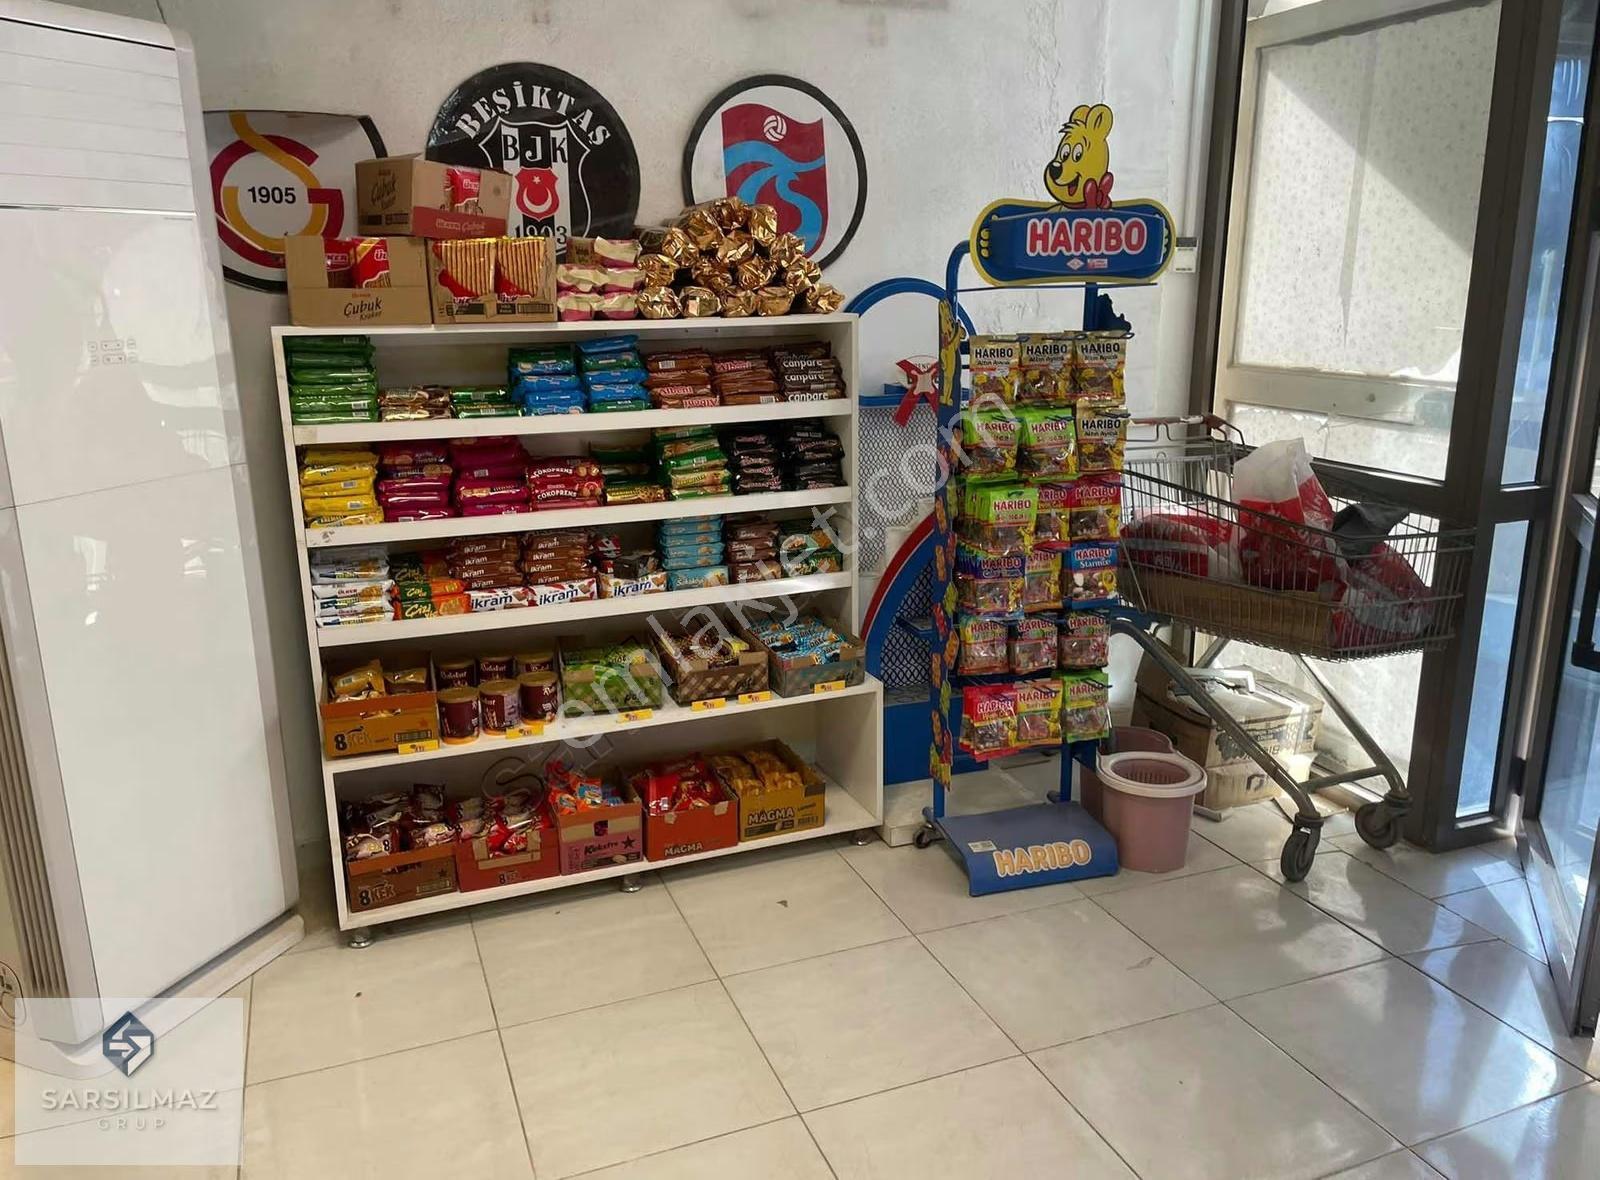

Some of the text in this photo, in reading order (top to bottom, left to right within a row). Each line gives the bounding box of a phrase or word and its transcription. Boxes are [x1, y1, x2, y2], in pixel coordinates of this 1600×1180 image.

[455, 81, 611, 146] BEŞİKTAŞ
[502, 134, 568, 163] BJK
[248, 187, 296, 204] 1905
[1027, 217, 1147, 256] HARIBO
[975, 347, 1013, 359] HARIBO
[1026, 344, 1067, 356] HARIBO
[1081, 342, 1120, 354] HARIBO
[1031, 421, 1068, 433] HARIBO
[1082, 419, 1121, 430] HARIBO
[1037, 488, 1067, 500] ARIBO
[1076, 486, 1117, 499] HARIBO
[993, 500, 1031, 511] HARIBO
[1027, 552, 1057, 563] ARIBO
[1075, 549, 1112, 561] HARIBO
[981, 557, 1022, 570] HARIBO
[613, 581, 653, 597] ikram
[471, 594, 513, 610] ikram
[539, 588, 579, 606] ikram
[1070, 617, 1105, 629] HARIBO
[334, 732, 348, 751] 8
[748, 807, 795, 825] MAGMA
[664, 842, 703, 857] MAGMA
[992, 839, 1092, 878] HARIBO
[359, 889, 372, 906] 8
